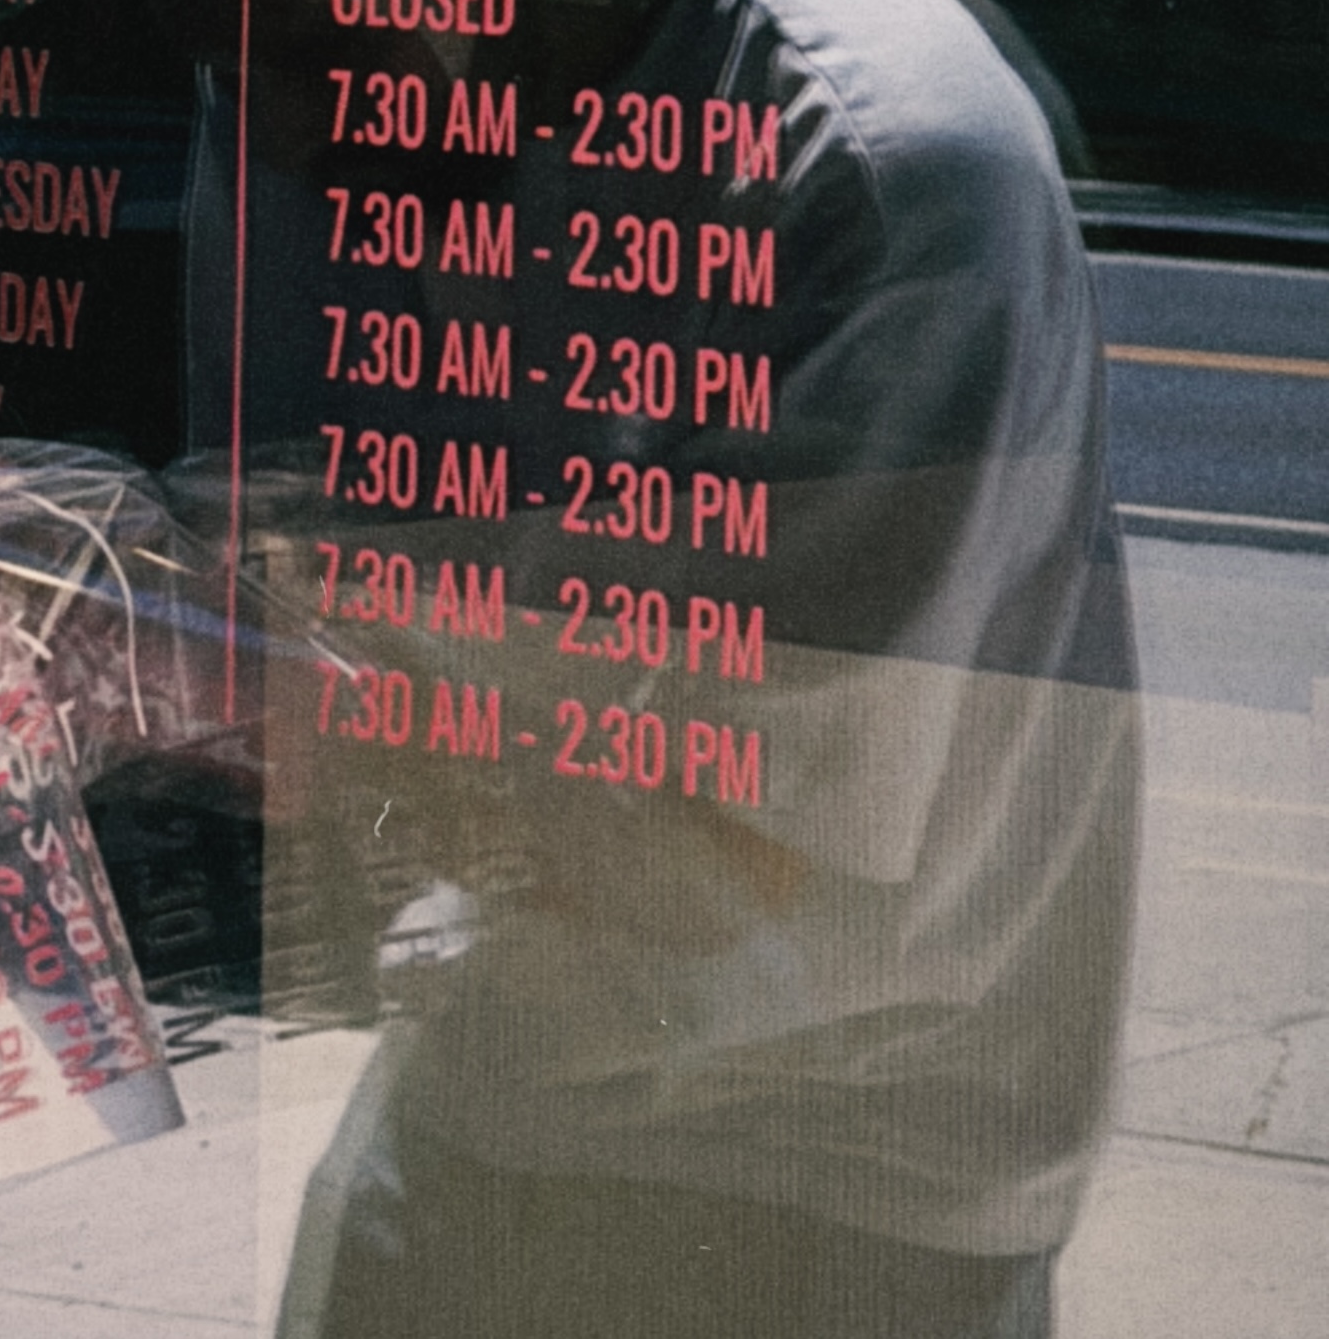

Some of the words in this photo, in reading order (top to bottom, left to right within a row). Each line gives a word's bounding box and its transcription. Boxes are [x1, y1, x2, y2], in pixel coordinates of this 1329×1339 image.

[327, 68, 427, 150] 7.30
[441, 78, 517, 157] AM
[534, 125, 554, 139] -
[570, 88, 683, 172] 2.30
[701, 98, 780, 181] PM
[325, 187, 424, 269] 7.30
[438, 198, 515, 278] AM
[532, 248, 551, 261] -
[567, 210, 680, 297] 2.30
[697, 223, 775, 308] PM
[322, 306, 422, 390] 7.30
[436, 320, 511, 399] AM
[527, 368, 547, 383] -
[563, 332, 677, 421] 2.30
[693, 347, 771, 433] PM
[319, 425, 418, 510] 7.30
[433, 441, 508, 522] AM
[526, 492, 544, 505] -
[560, 455, 673, 545] 2.30
[690, 472, 768, 558] PM
[316, 541, 416, 629] 7.30
[428, 560, 505, 642] AM
[522, 611, 541, 626] -
[557, 577, 670, 669] 2.30
[686, 596, 765, 684] PM
[313, 660, 413, 747] 7.30
[426, 680, 501, 761] AM
[517, 732, 537, 747] -
[553, 699, 667, 790] 2.30
[682, 720, 761, 806] PM
[43, 1000, 108, 1094] PM
